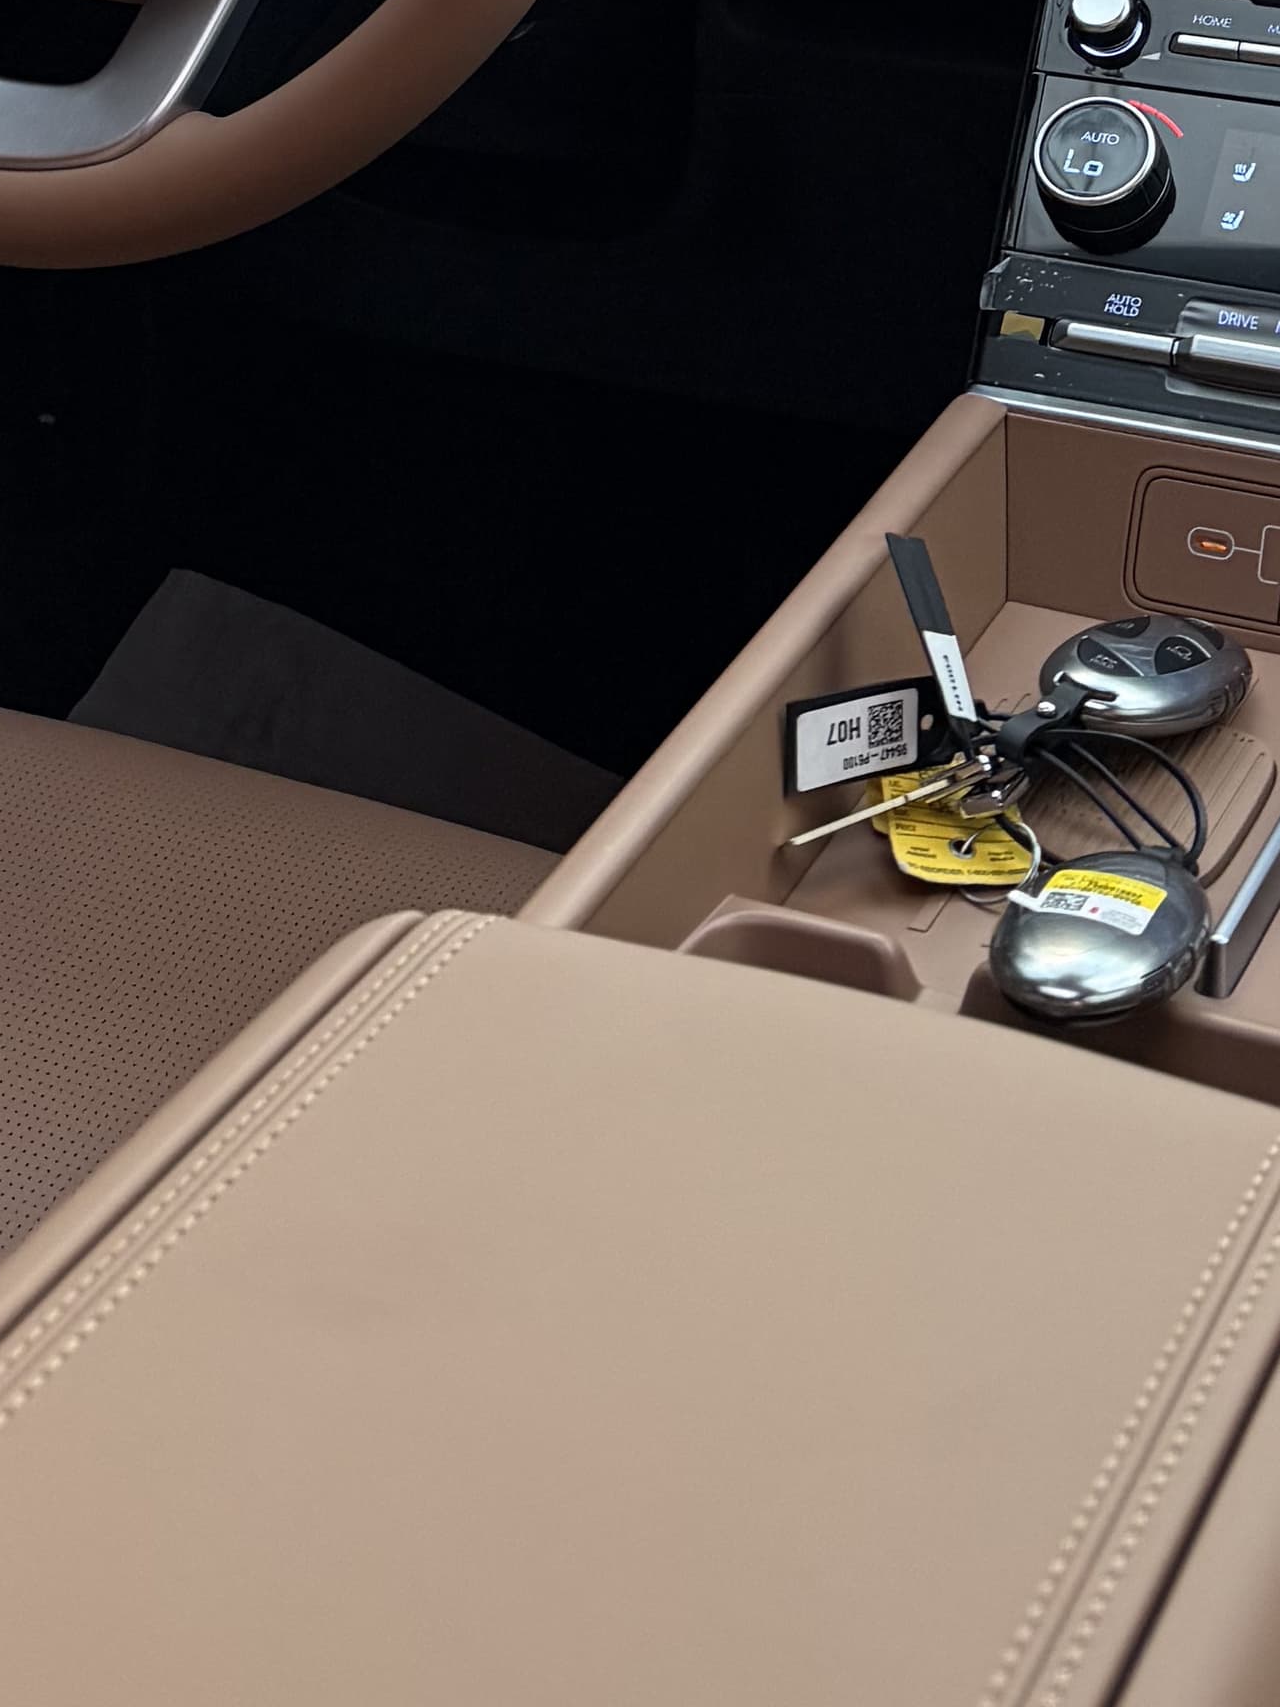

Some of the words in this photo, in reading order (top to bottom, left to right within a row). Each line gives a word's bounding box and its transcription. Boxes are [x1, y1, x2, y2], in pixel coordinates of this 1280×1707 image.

[1192, 14, 1232, 28] HOME
[1080, 131, 1120, 145] AUTO
[1063, 148, 1104, 176] Lo
[1106, 293, 1142, 308] AUTO
[1103, 303, 1140, 317] HOLD
[1218, 310, 1259, 330] DRIVE
[827, 715, 862, 745] H07
